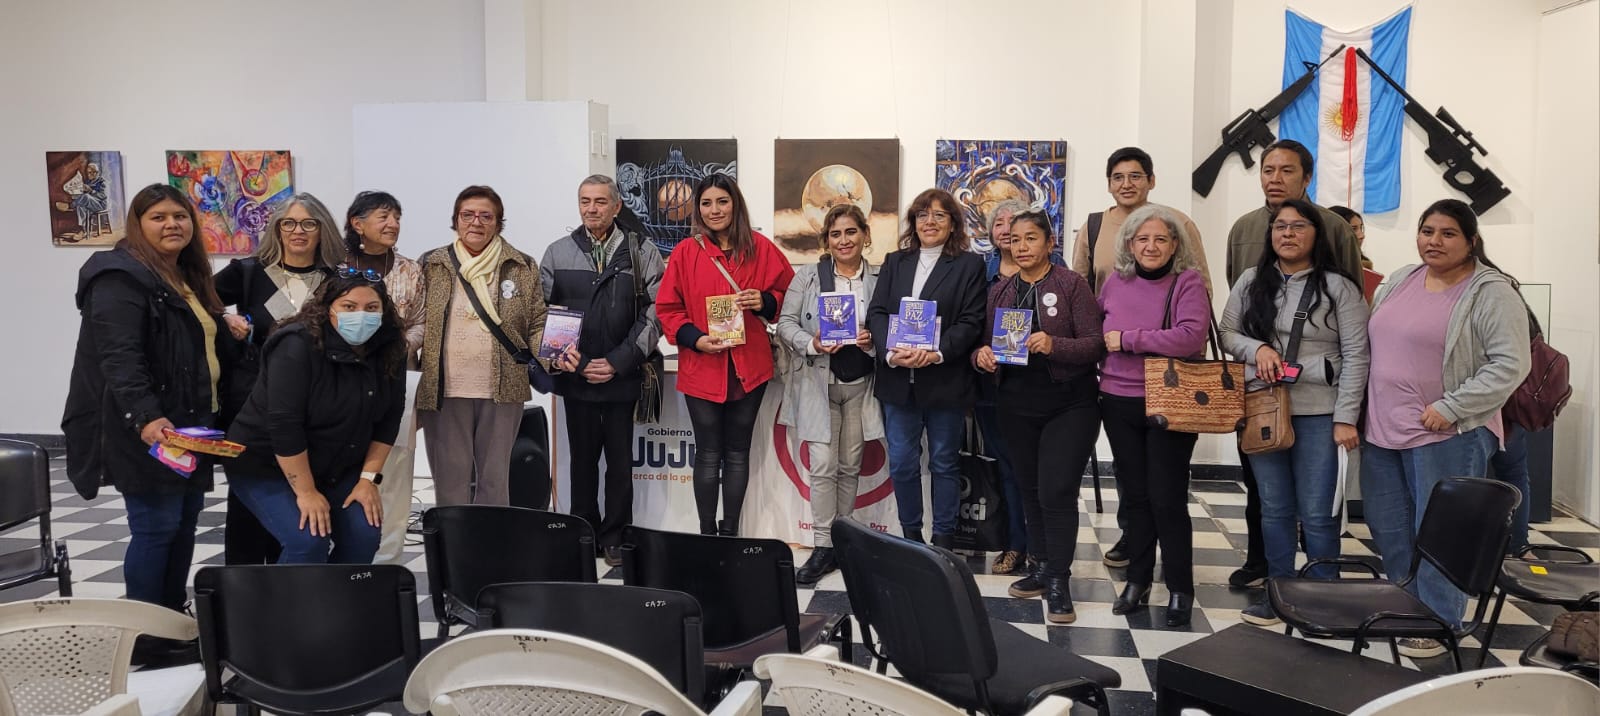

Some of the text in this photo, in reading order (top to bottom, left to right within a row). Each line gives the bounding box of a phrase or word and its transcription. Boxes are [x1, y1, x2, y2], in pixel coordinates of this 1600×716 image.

[905, 309, 923, 321] PAZ
[1007, 319, 1025, 332] PAZ
[647, 428, 692, 437] Gobierno
[669, 473, 679, 481] la
[743, 546, 763, 554] CAJA
